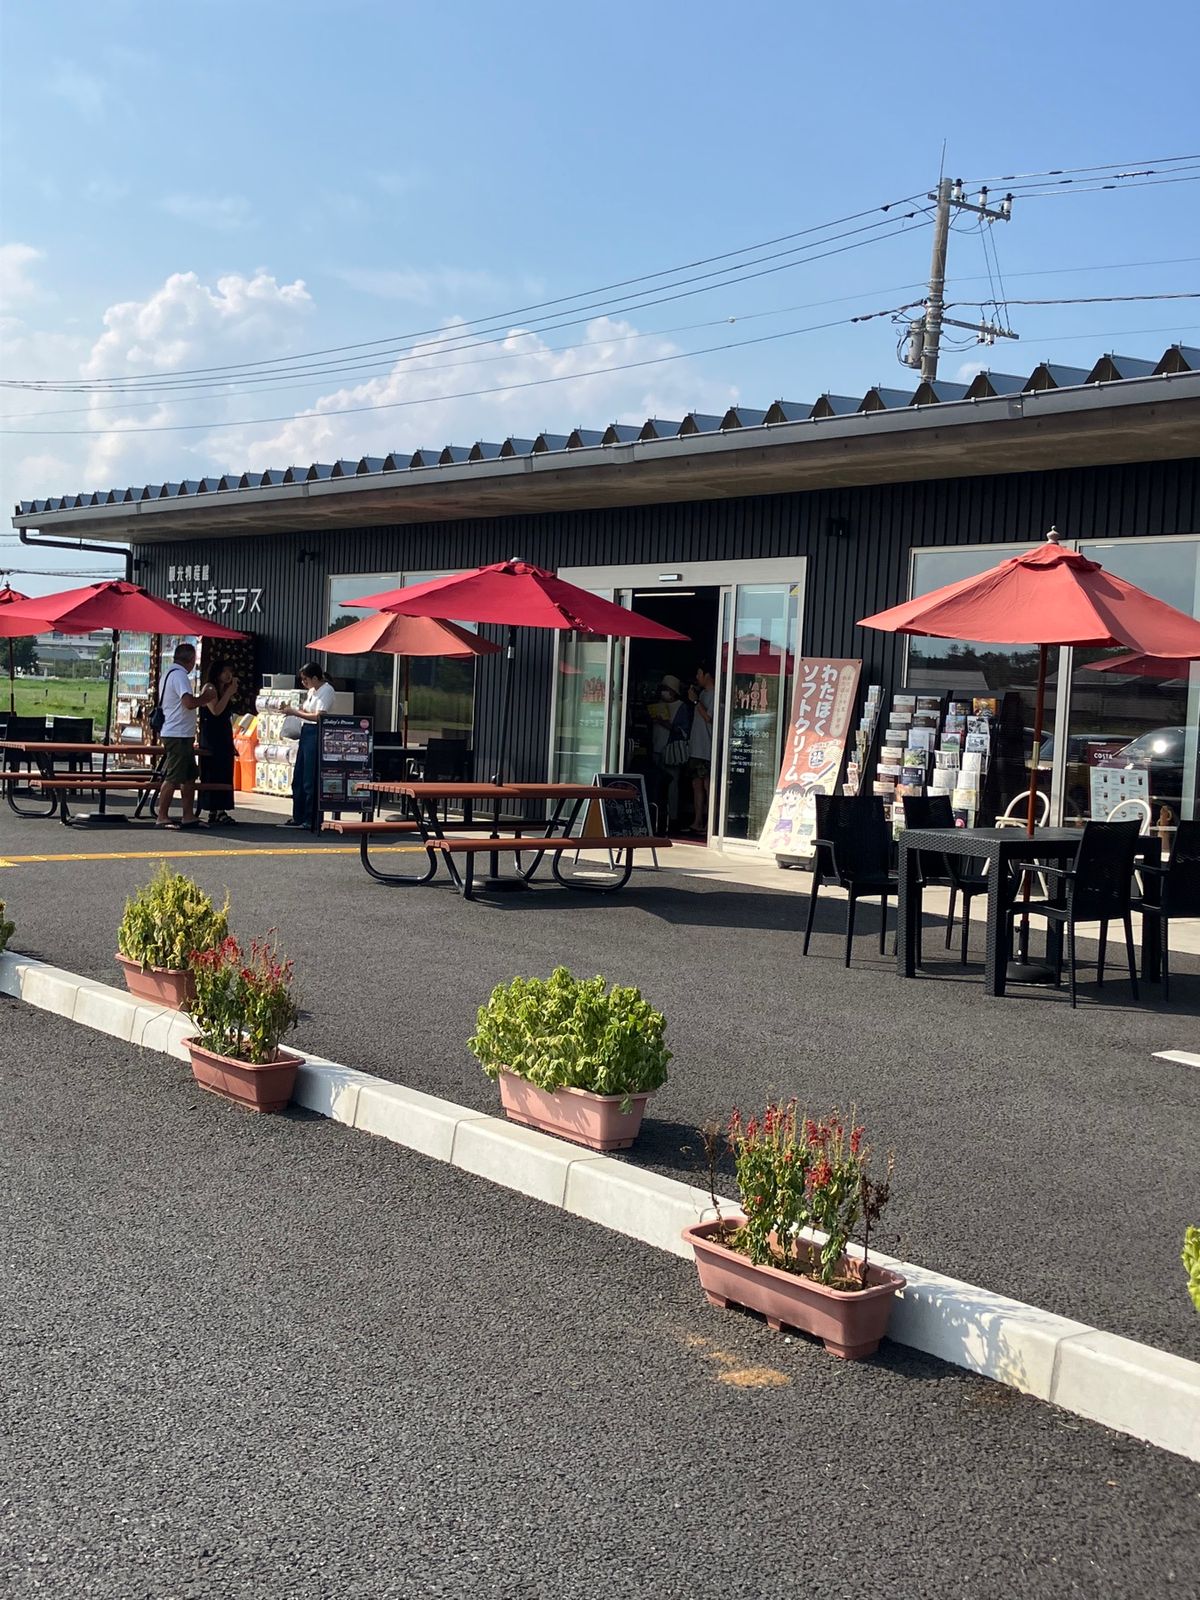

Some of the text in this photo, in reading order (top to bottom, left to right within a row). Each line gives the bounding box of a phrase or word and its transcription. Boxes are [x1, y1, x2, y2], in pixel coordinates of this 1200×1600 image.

[168, 564, 209, 582] 観光物産館
[784, 665, 819, 782] ソフトクリーム
[1093, 752, 1113, 760] COSTA
